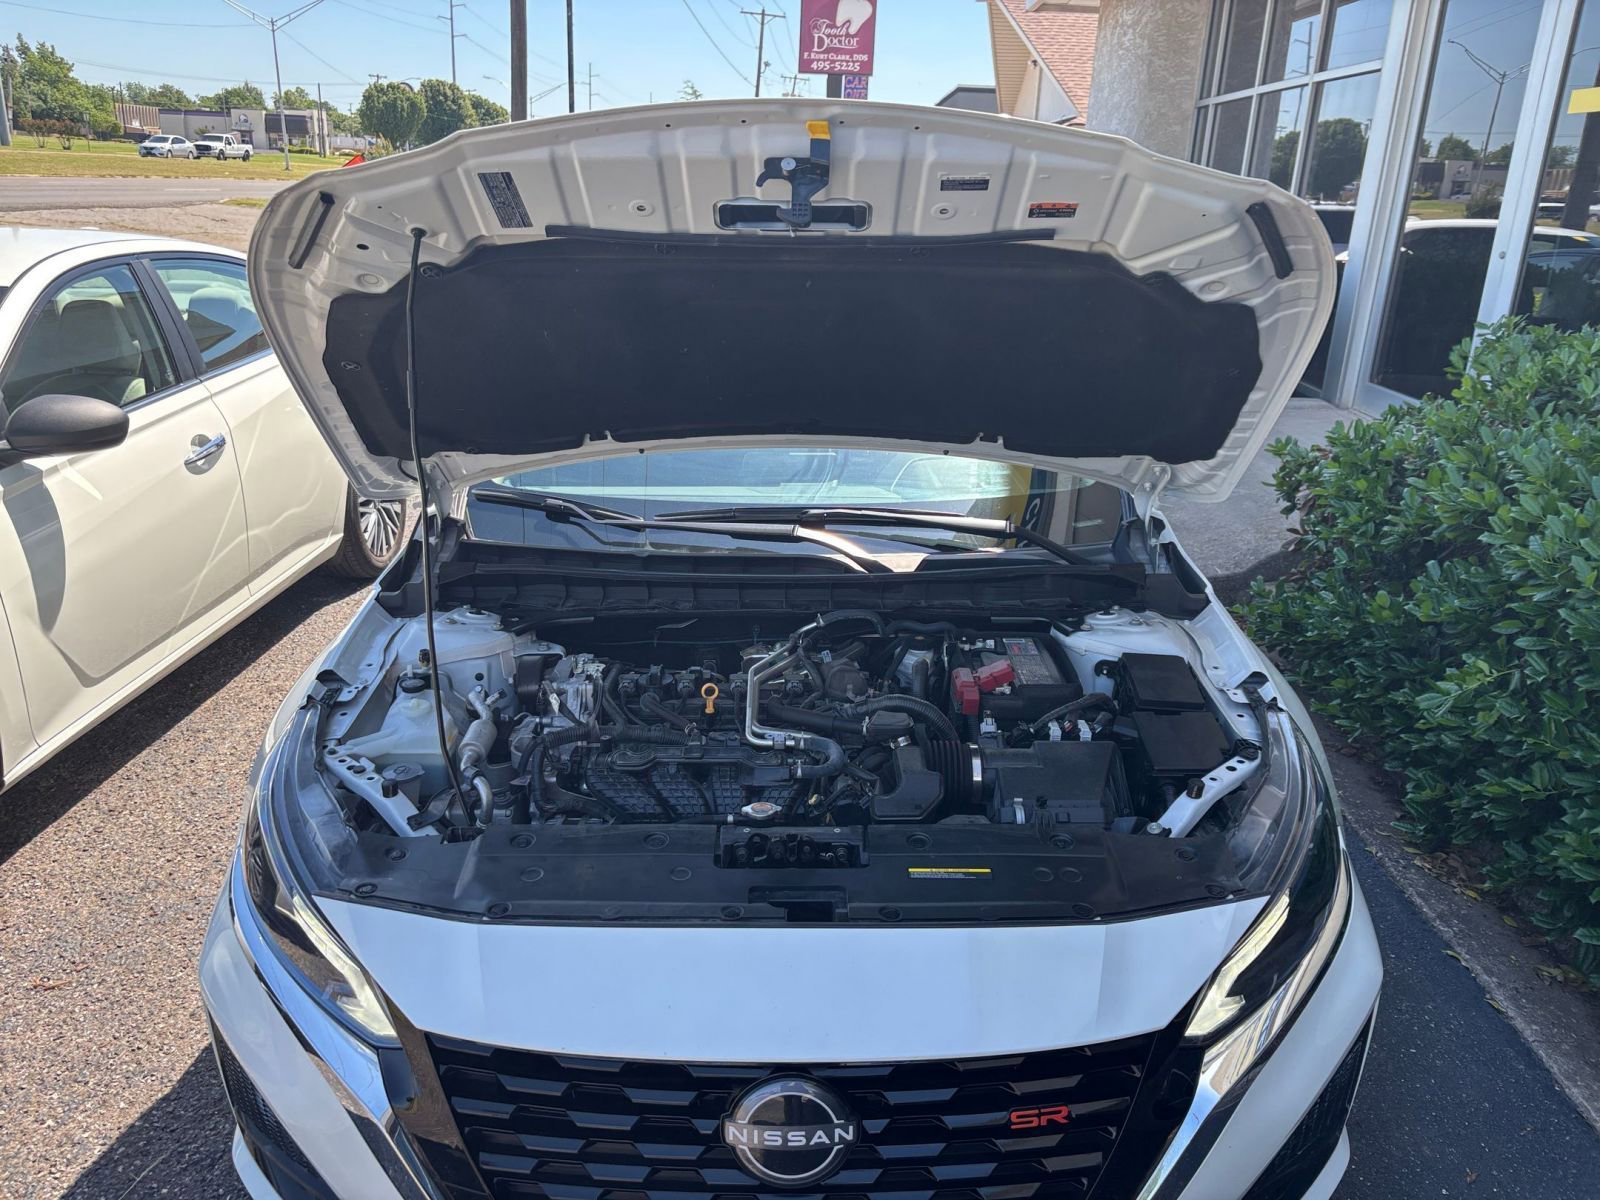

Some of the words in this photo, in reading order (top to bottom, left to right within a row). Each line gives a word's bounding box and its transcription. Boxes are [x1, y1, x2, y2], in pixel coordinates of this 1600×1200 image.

[809, 17, 849, 36] Tooth
[811, 61, 860, 71] 495-5225
[853, 53, 868, 61] DDS
[1010, 1105, 1070, 1129] SR
[728, 1125, 853, 1146] NISSAN
